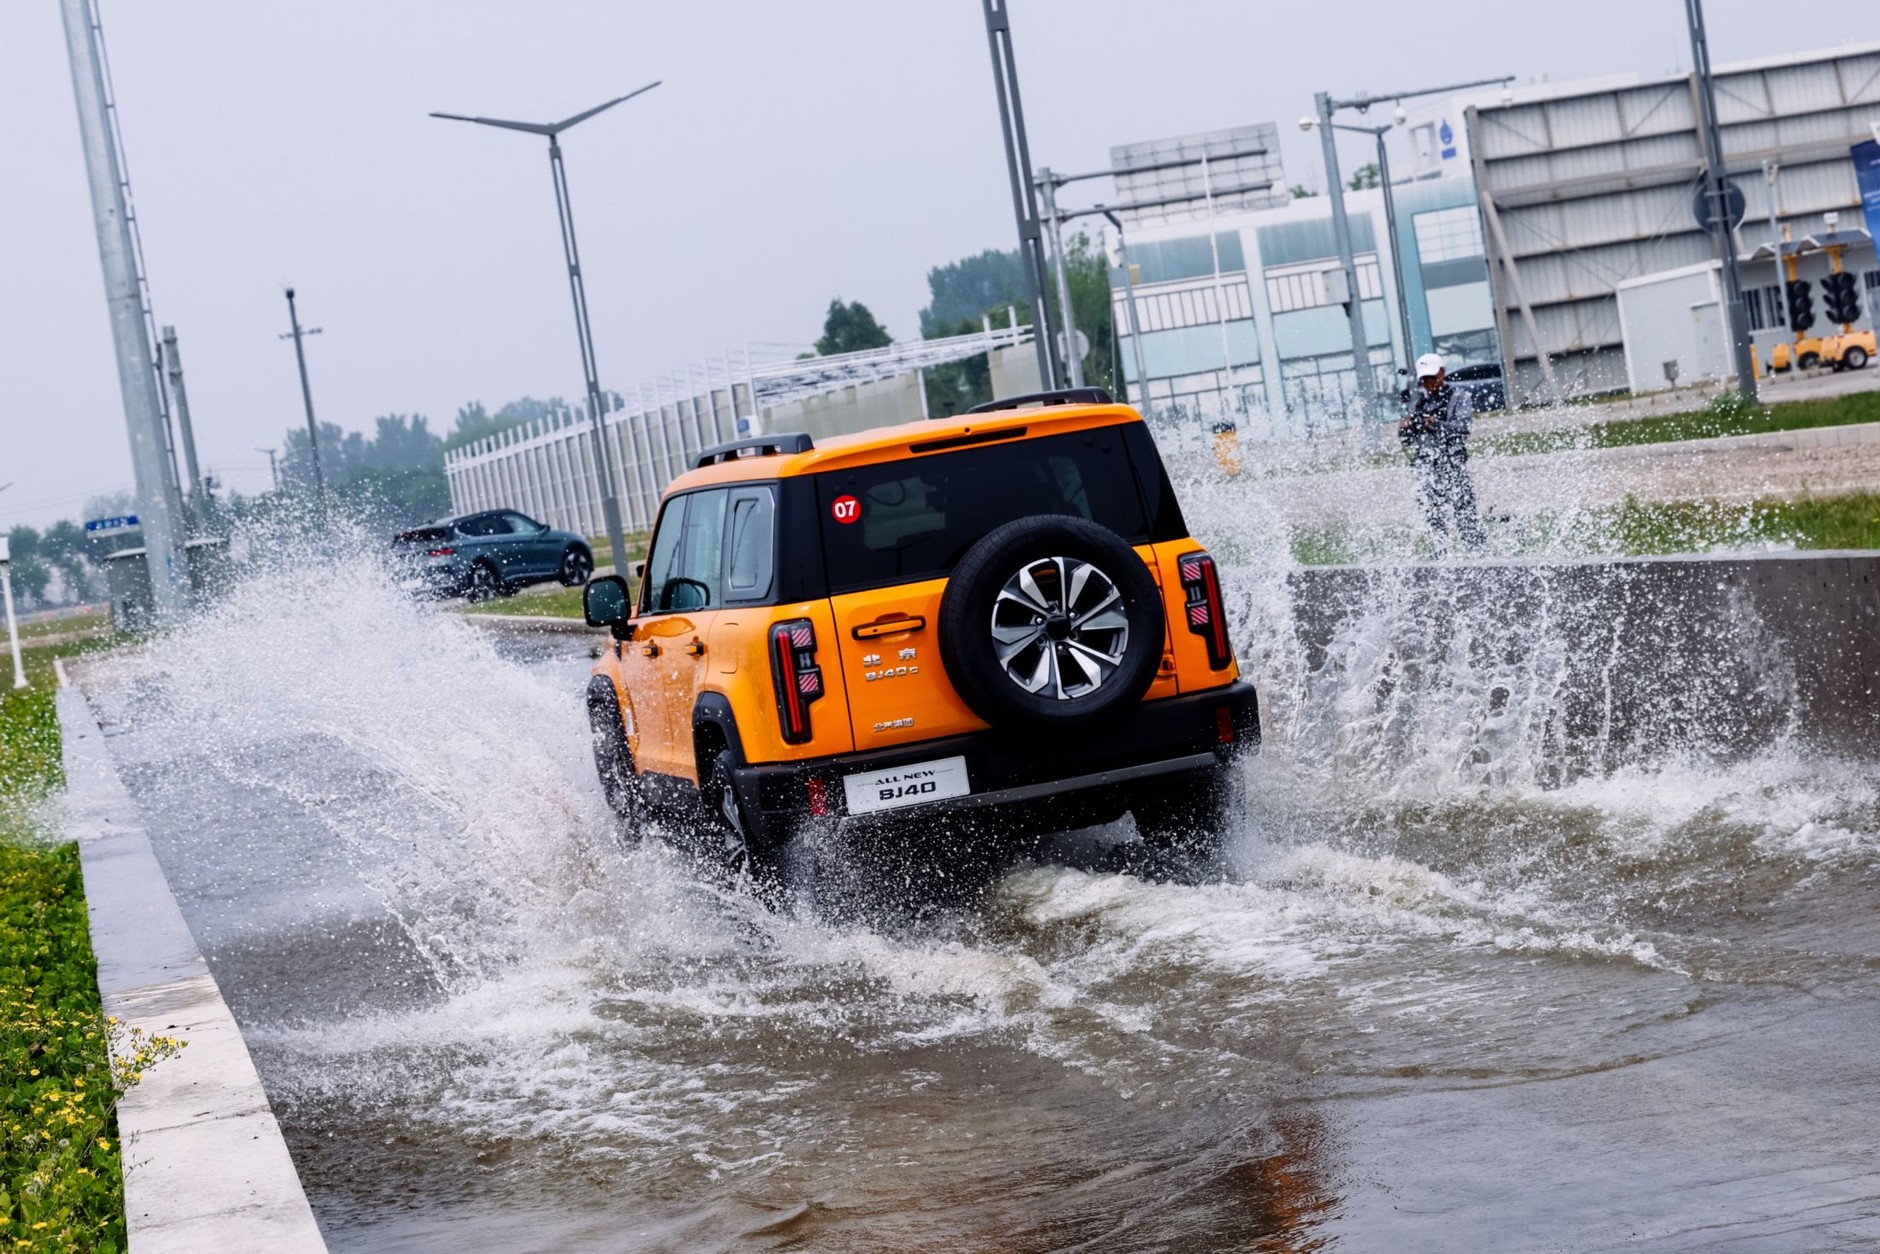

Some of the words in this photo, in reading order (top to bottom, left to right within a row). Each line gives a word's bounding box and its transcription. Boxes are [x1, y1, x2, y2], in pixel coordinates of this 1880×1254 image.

[835, 500, 856, 518] 07
[875, 776, 902, 786] ALL
[904, 769, 936, 780] NEW
[879, 781, 936, 801] BJ40
